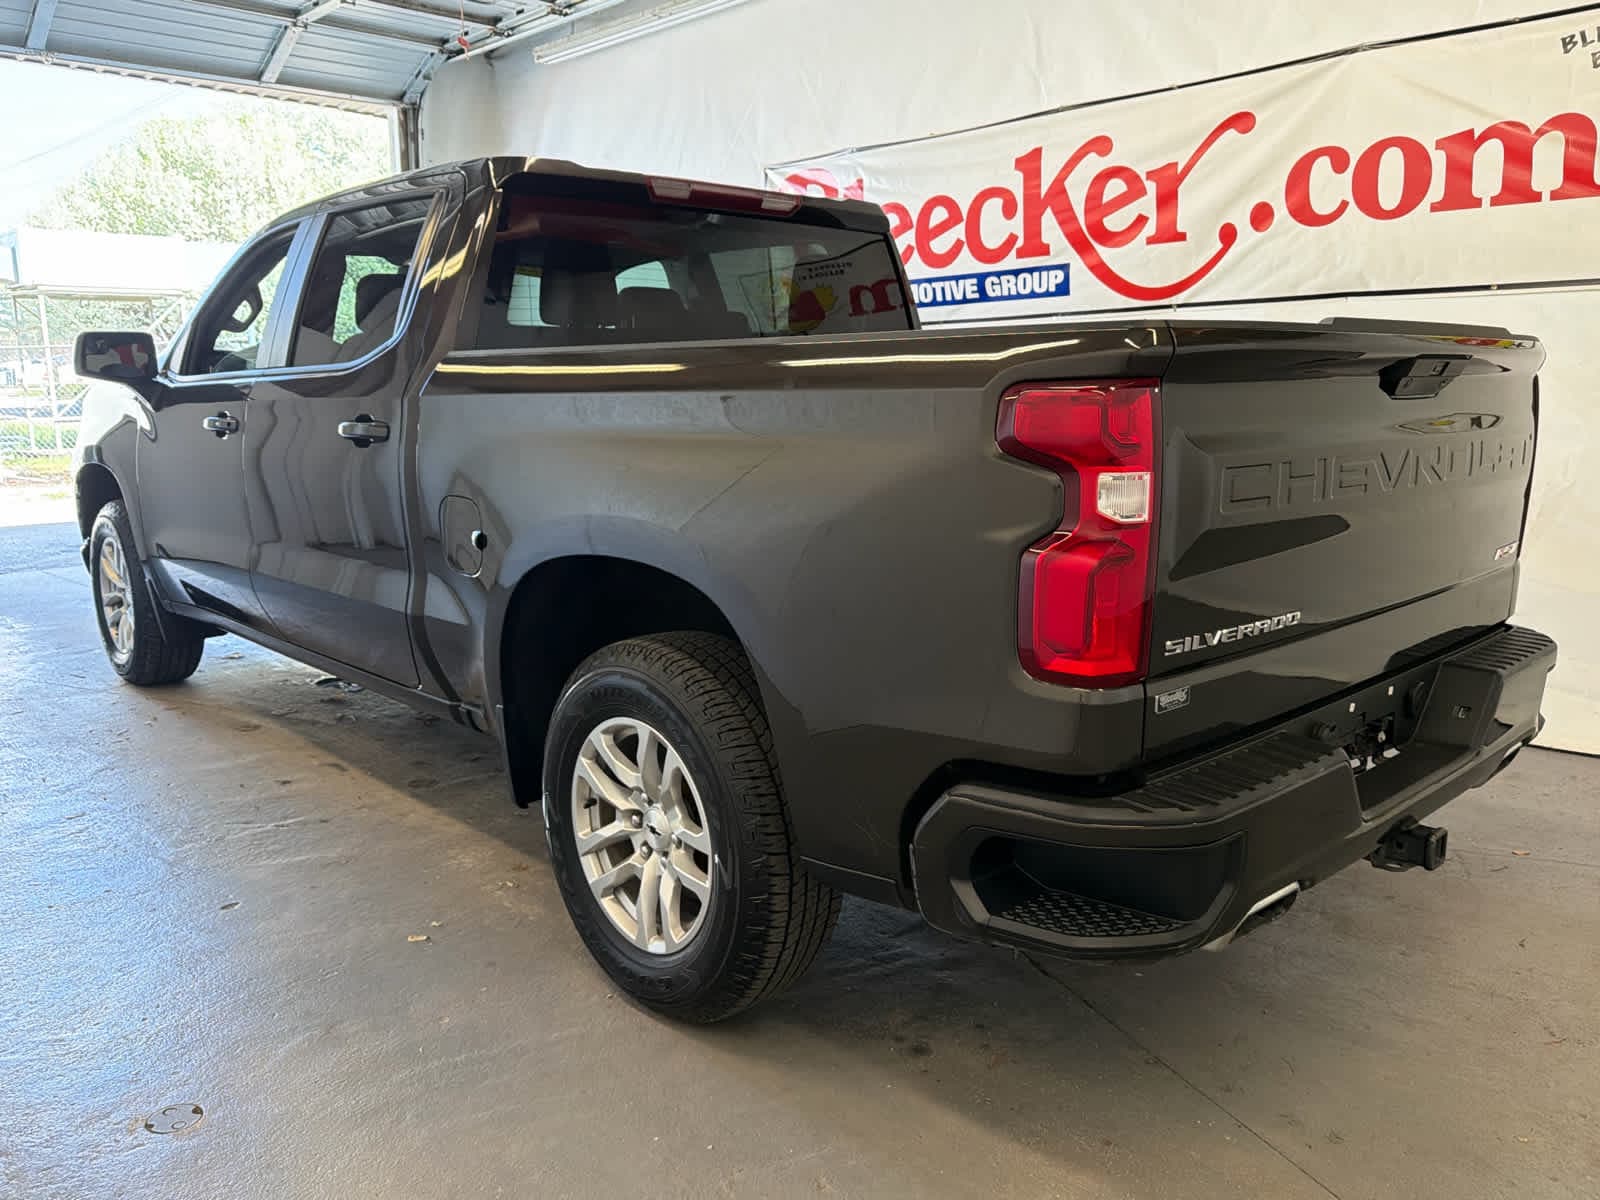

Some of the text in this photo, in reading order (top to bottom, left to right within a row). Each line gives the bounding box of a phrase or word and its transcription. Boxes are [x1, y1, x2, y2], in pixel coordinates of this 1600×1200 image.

[785, 111, 1600, 302] eecker.com
[984, 269, 1065, 298] GROUP
[1164, 610, 1301, 656] SILVERADO
